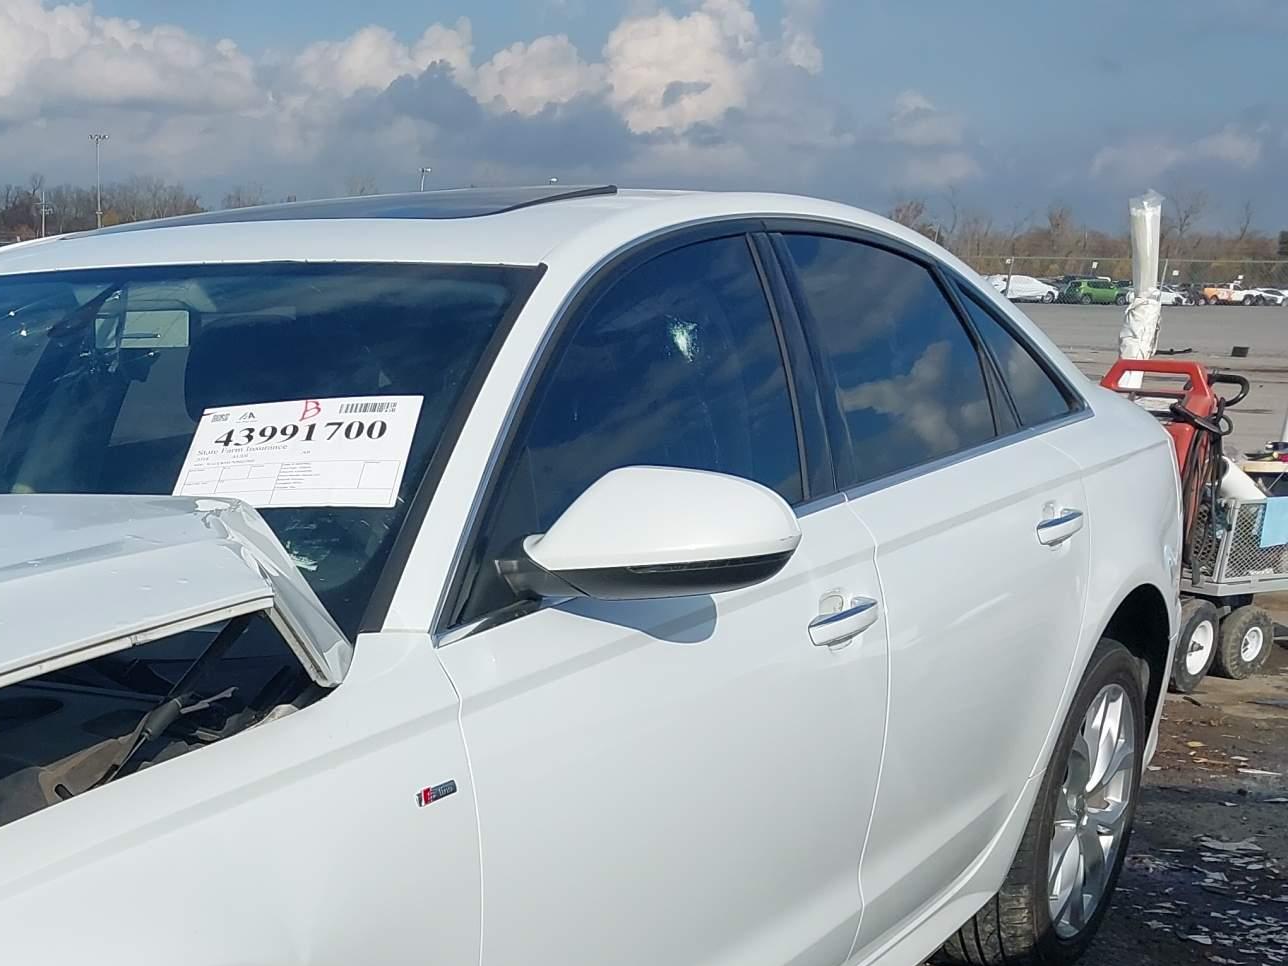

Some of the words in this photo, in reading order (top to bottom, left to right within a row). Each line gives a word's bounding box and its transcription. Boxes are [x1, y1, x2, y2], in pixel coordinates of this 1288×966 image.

[299, 399, 321, 421] B
[214, 419, 387, 447] 43991700
[197, 448, 219, 456] State
[221, 447, 244, 455] Farm
[246, 444, 288, 453] Insurance
